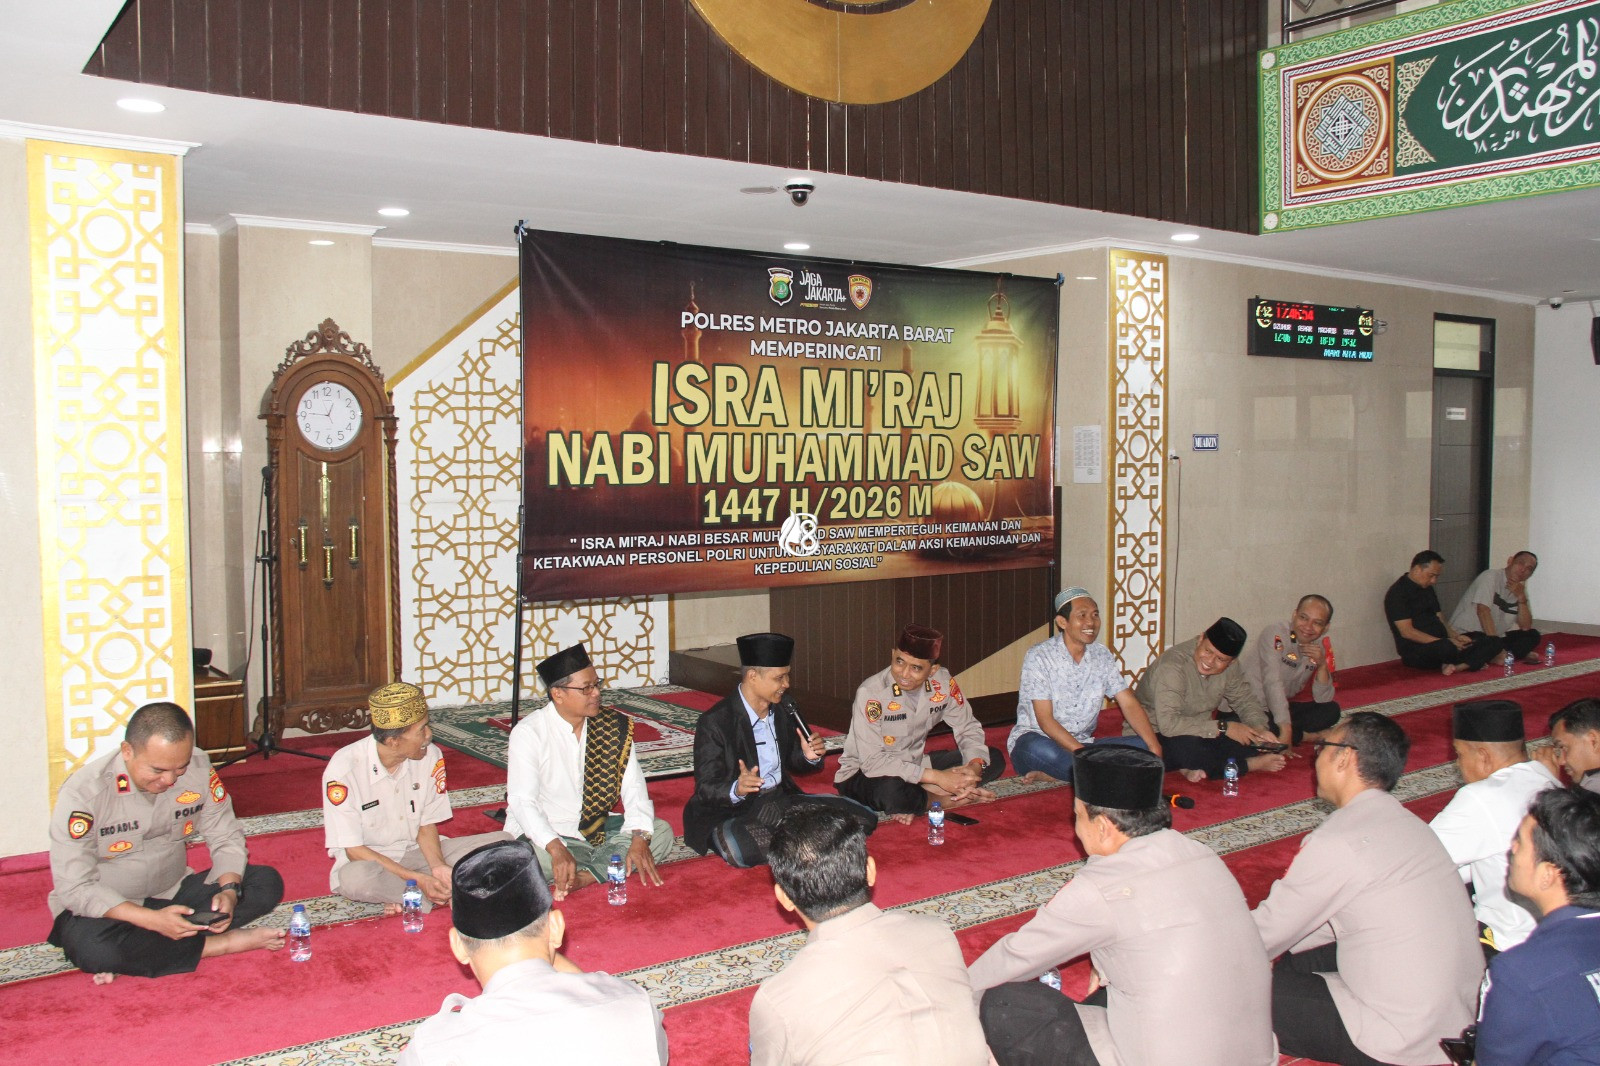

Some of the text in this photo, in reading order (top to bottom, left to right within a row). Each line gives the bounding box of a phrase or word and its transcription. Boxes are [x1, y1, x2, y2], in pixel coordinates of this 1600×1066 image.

[800, 271, 822, 286] JAGA
[681, 312, 954, 343] POLRES METRO JAKARTA BARAT
[750, 340, 882, 361] MEMPERINGATI
[312, 390, 319, 399] 11
[322, 387, 332, 397] 12
[652, 361, 789, 427] ISRA
[303, 400, 312, 409] 10
[345, 398, 352, 407] 2
[300, 411, 307, 420] 9
[350, 410, 356, 420] 3
[304, 423, 311, 433] 8
[345, 422, 353, 431] 4
[315, 431, 320, 440] 7
[326, 434, 333, 445] 6
[337, 431, 345, 440] 5
[547, 431, 670, 486] NABI
[685, 432, 954, 484] MUHAMMAD
[962, 434, 1040, 481] SAW
[703, 488, 781, 524] 1447
[908, 484, 932, 518] M
[581, 537, 614, 550] ISRA
[619, 535, 664, 549] MI'RAJ
[669, 534, 701, 546] NABI
[705, 532, 749, 545] BESAR
[829, 528, 856, 540] SAW
[859, 524, 942, 537] MEMPERTEGUH
[945, 521, 998, 534] KEIMANAN
[1001, 520, 1022, 531] DAN
[533, 554, 625, 570] KETAKWAAN
[629, 551, 703, 565] PERSONEL
[707, 548, 746, 562] POLRI
[750, 546, 792, 560] UNTUK
[877, 540, 916, 552] DALAM
[919, 539, 944, 550] AKSI
[946, 534, 1019, 548] KEMANUSIAAN
[1022, 533, 1041, 543] DAN
[755, 559, 832, 575] KEPEDULIAN
[100, 826, 115, 837] EKO
